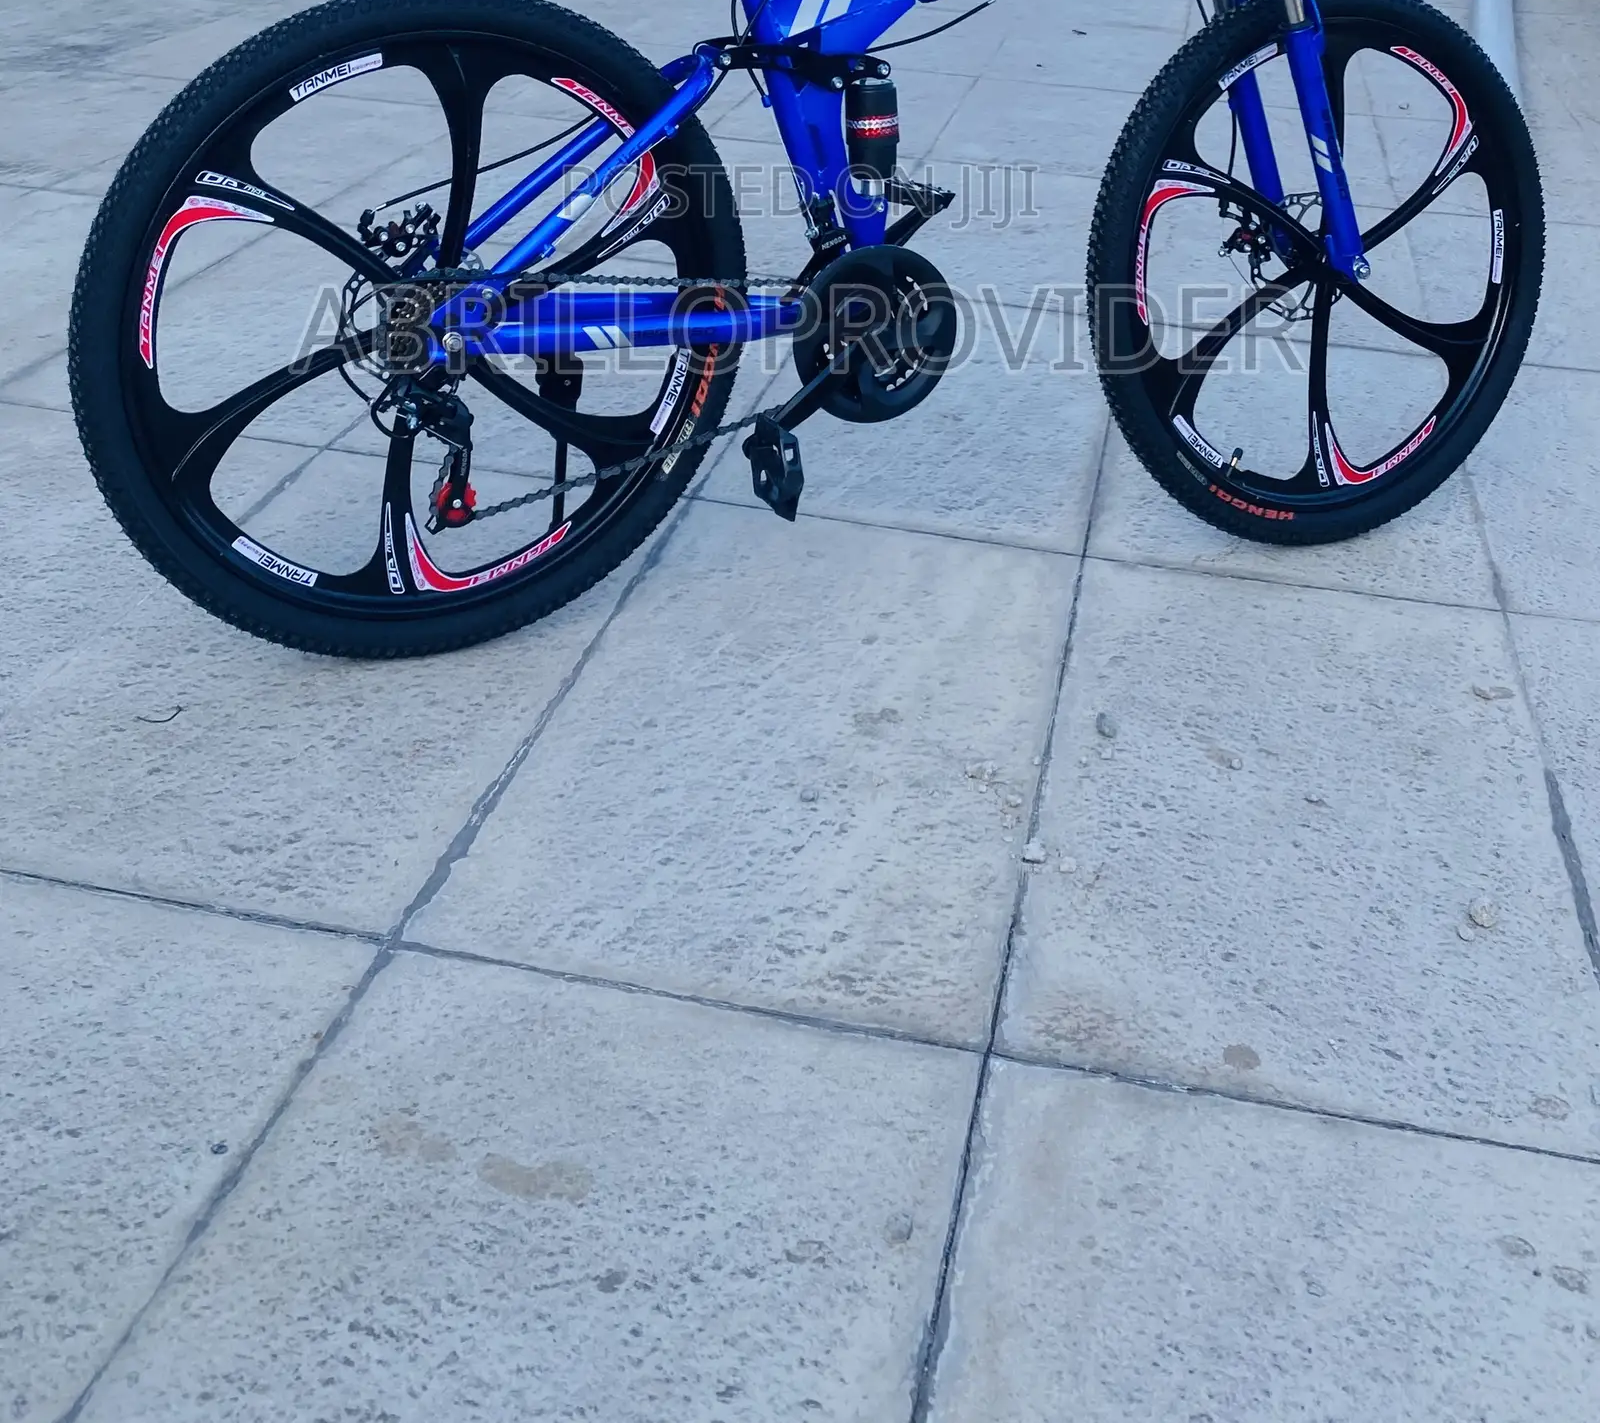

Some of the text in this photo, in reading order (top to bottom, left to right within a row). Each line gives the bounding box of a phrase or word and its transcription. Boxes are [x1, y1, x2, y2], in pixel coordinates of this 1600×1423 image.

[293, 64, 351, 97] TANMEI
[1220, 54, 1258, 86] TANMEI
[571, 83, 636, 139] TANME
[1495, 211, 1503, 258] TANMEI
[139, 245, 165, 346] TANMEI
[664, 350, 692, 407] TANMEI
[1187, 433, 1221, 466] TANMEI
[258, 553, 313, 584] TANMEI
